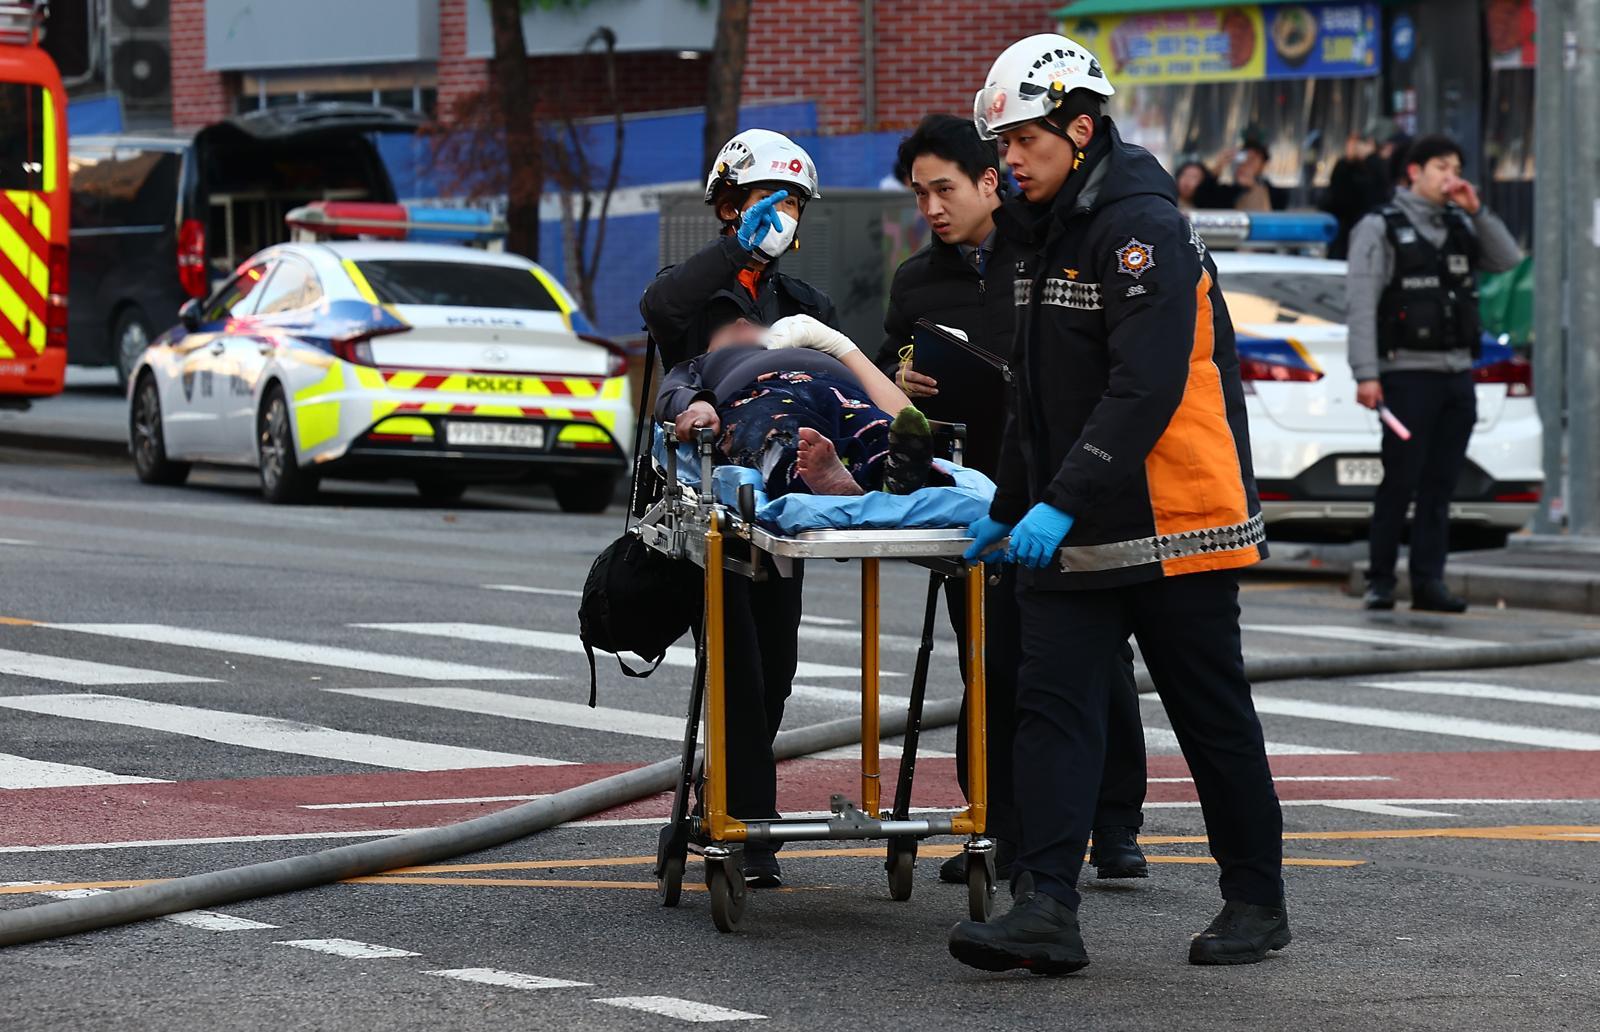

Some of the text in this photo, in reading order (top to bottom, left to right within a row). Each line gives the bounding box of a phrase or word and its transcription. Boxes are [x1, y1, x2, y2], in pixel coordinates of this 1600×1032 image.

[465, 377, 524, 392] POLICE
[1083, 443, 1113, 463] GORE-TEX
[887, 543, 940, 553] SUNGWOO
